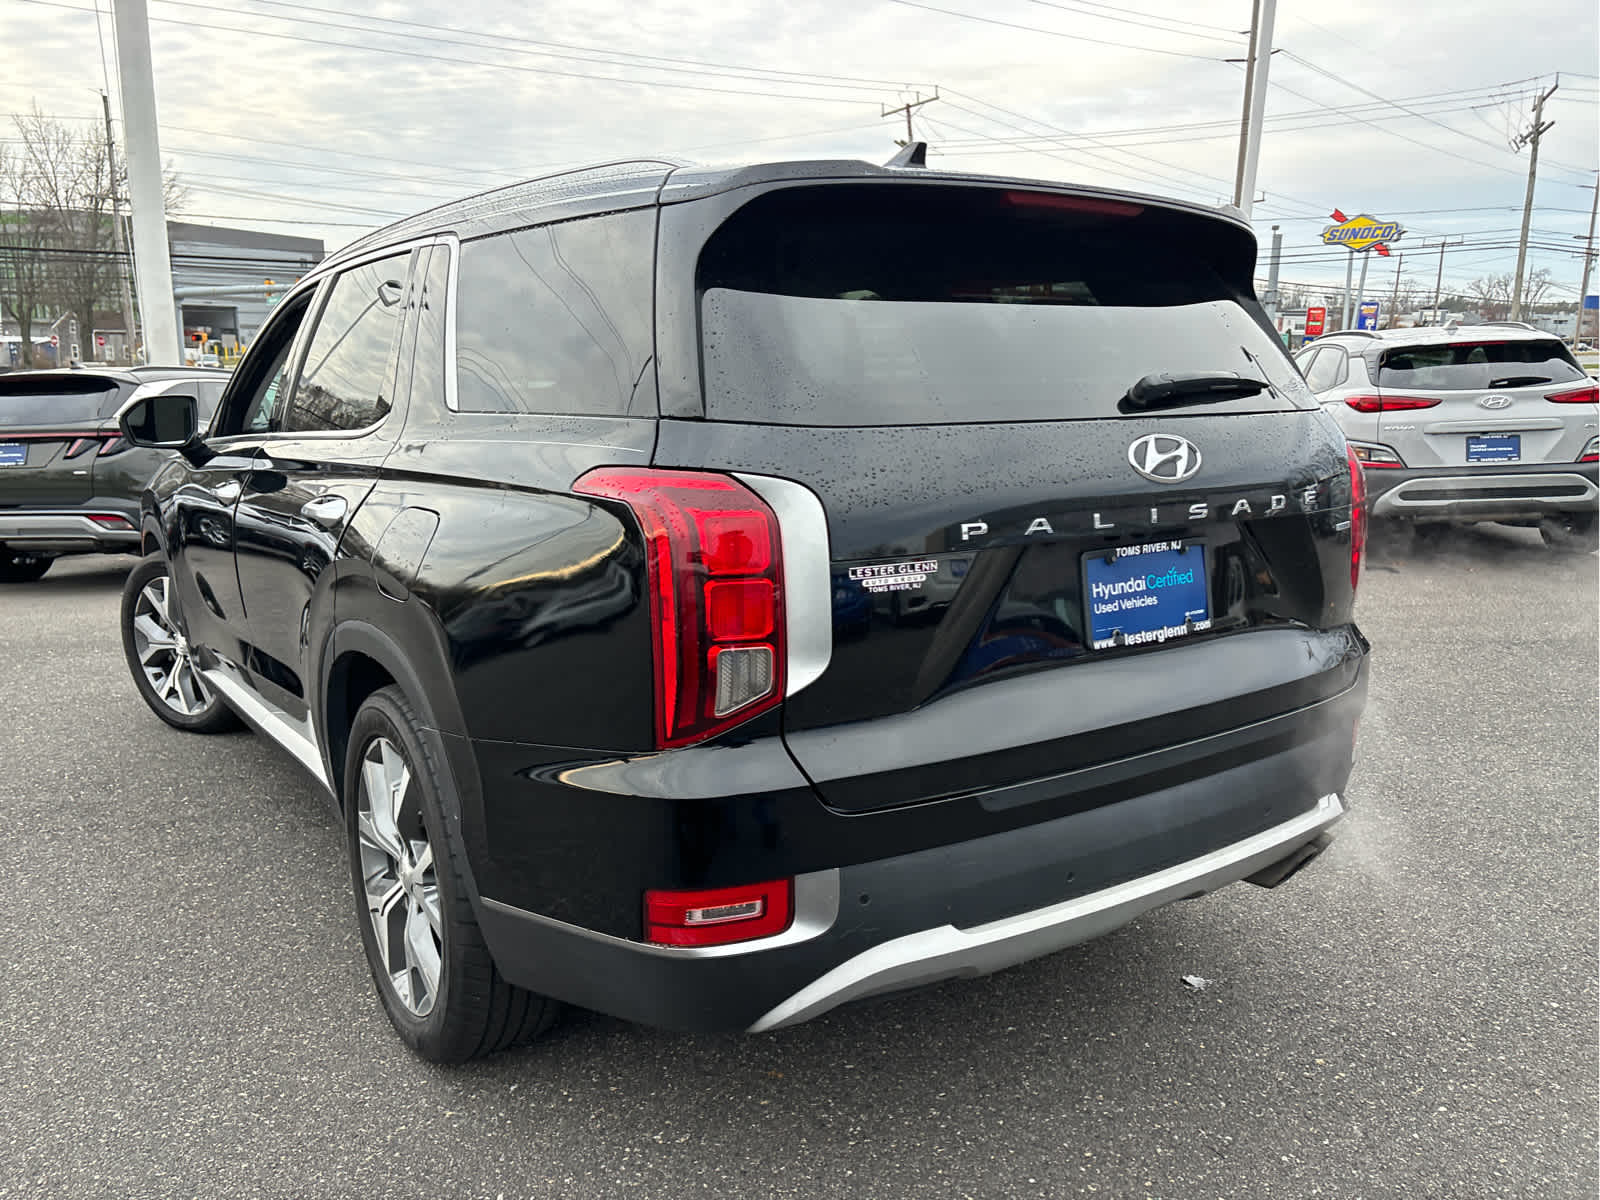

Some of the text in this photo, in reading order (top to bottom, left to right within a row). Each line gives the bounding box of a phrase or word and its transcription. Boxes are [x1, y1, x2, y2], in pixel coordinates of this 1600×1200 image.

[1327, 225, 1393, 241] SUNOCO
[960, 490, 1317, 541] PALISADE
[1116, 546, 1141, 557] TOMS
[1171, 540, 1182, 550] NJ
[849, 562, 937, 578] LESTER GLENN
[865, 578, 889, 586] AUTO
[1092, 567, 1194, 599] Hyundai Certified
[1094, 595, 1158, 614] Used Vehicles
[1124, 625, 1187, 646] lesterglenn
